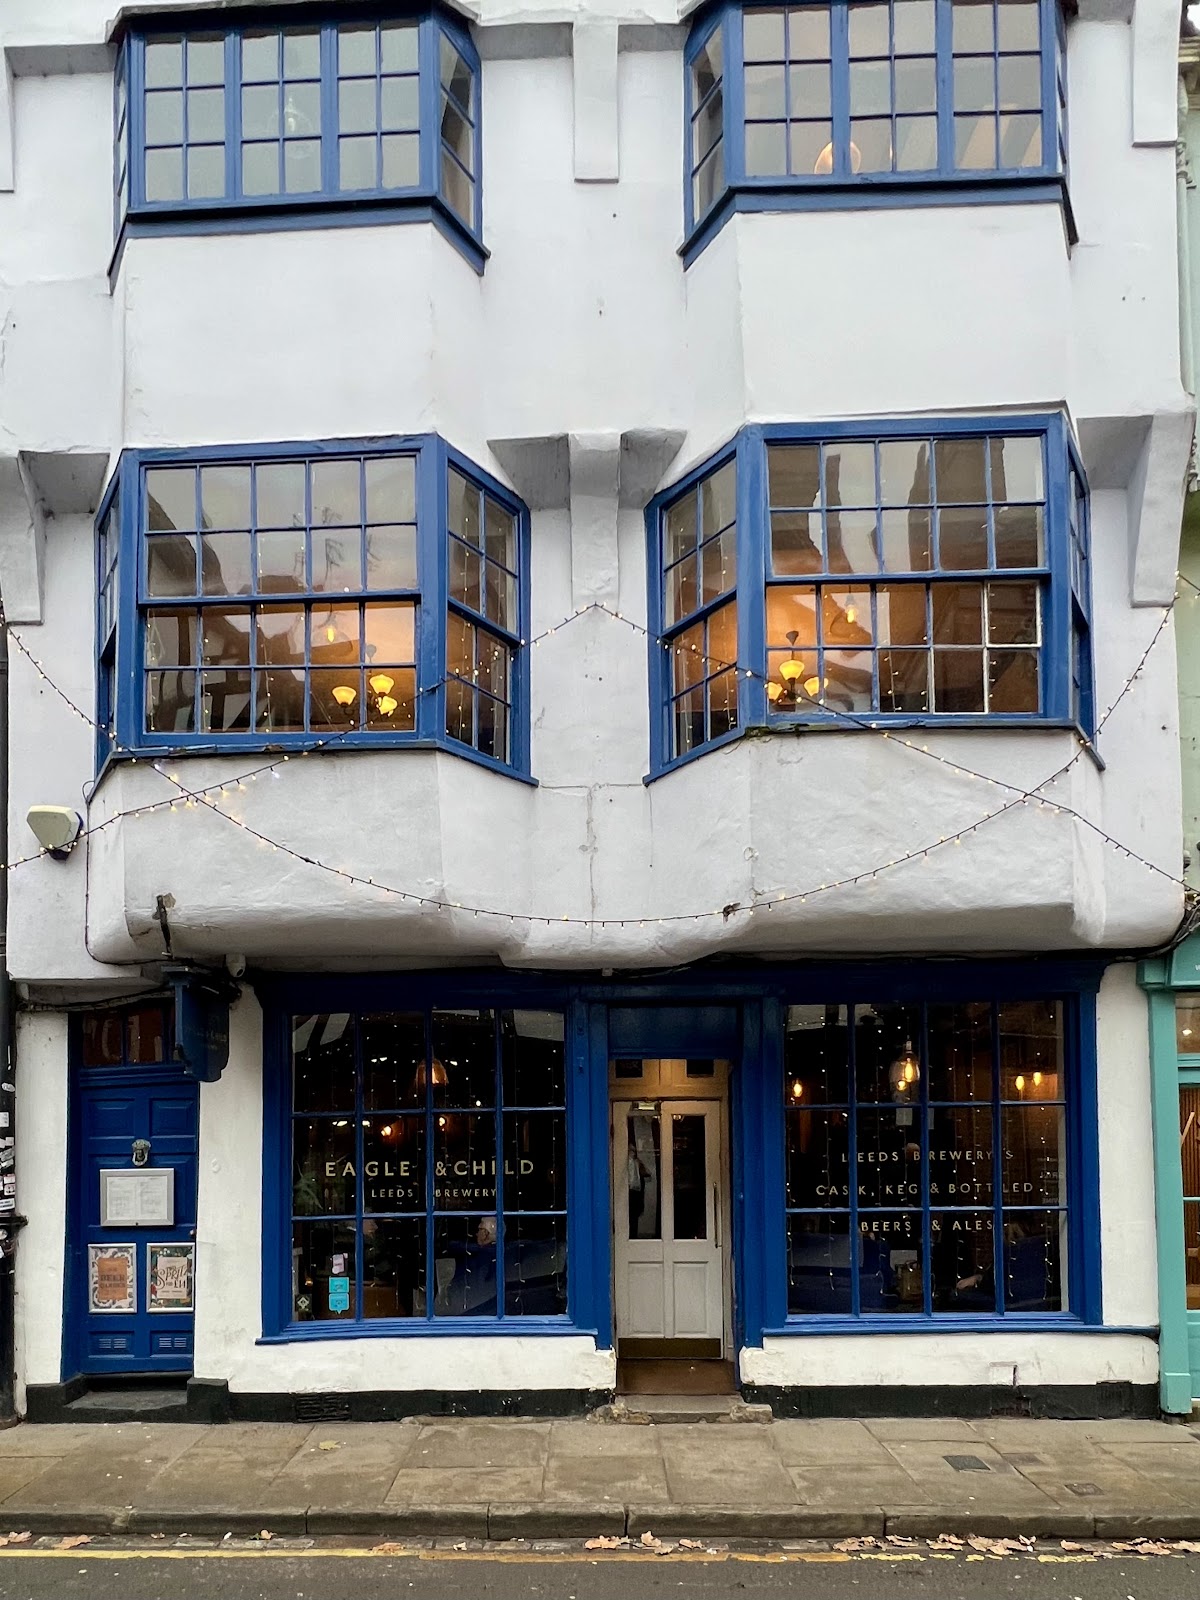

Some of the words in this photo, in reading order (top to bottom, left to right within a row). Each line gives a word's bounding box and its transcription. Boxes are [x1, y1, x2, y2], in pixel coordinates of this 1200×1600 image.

[841, 1151, 899, 1163] LEEDS
[325, 1160, 410, 1177] EAGLE
[371, 1188, 413, 1198] LEEDS
[435, 1188, 496, 1198] BREWERY
[885, 1183, 918, 1195] KEG
[930, 1182, 940, 1194] &
[948, 1182, 1033, 1194] BOTTLED
[861, 1221, 912, 1232] BEERS
[931, 1219, 941, 1231] &
[952, 1219, 993, 1231] ALES
